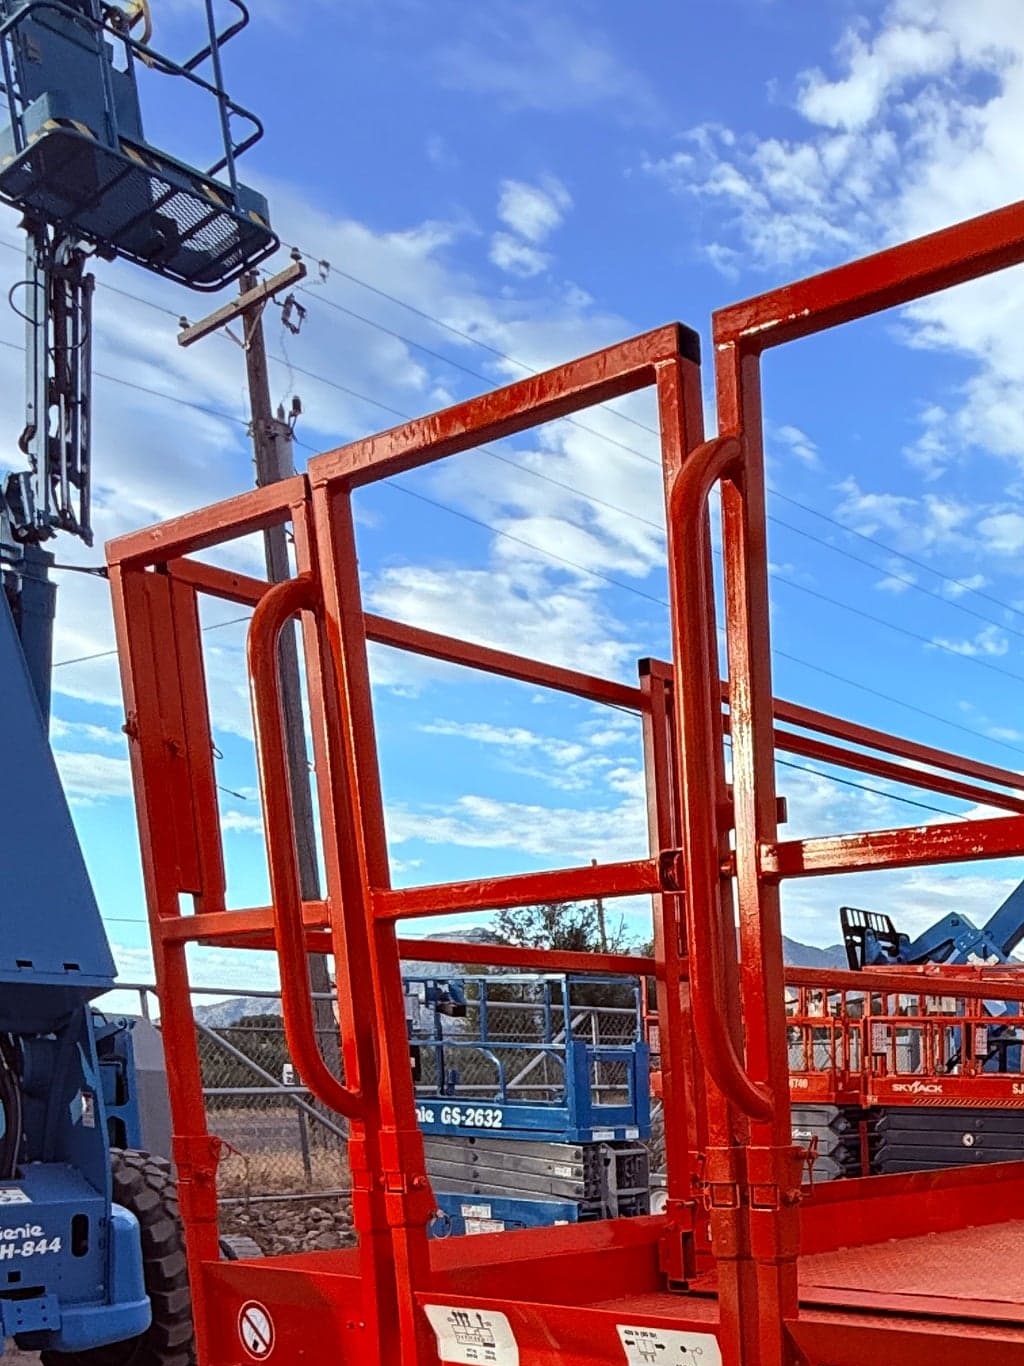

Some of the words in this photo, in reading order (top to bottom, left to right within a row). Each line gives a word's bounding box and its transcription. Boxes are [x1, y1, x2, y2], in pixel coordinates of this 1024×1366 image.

[892, 1080, 943, 1093] SKYJACK
[415, 1106, 434, 1123] nie
[441, 1107, 502, 1127] GS-2632
[0, 1237, 61, 1259] H-844
